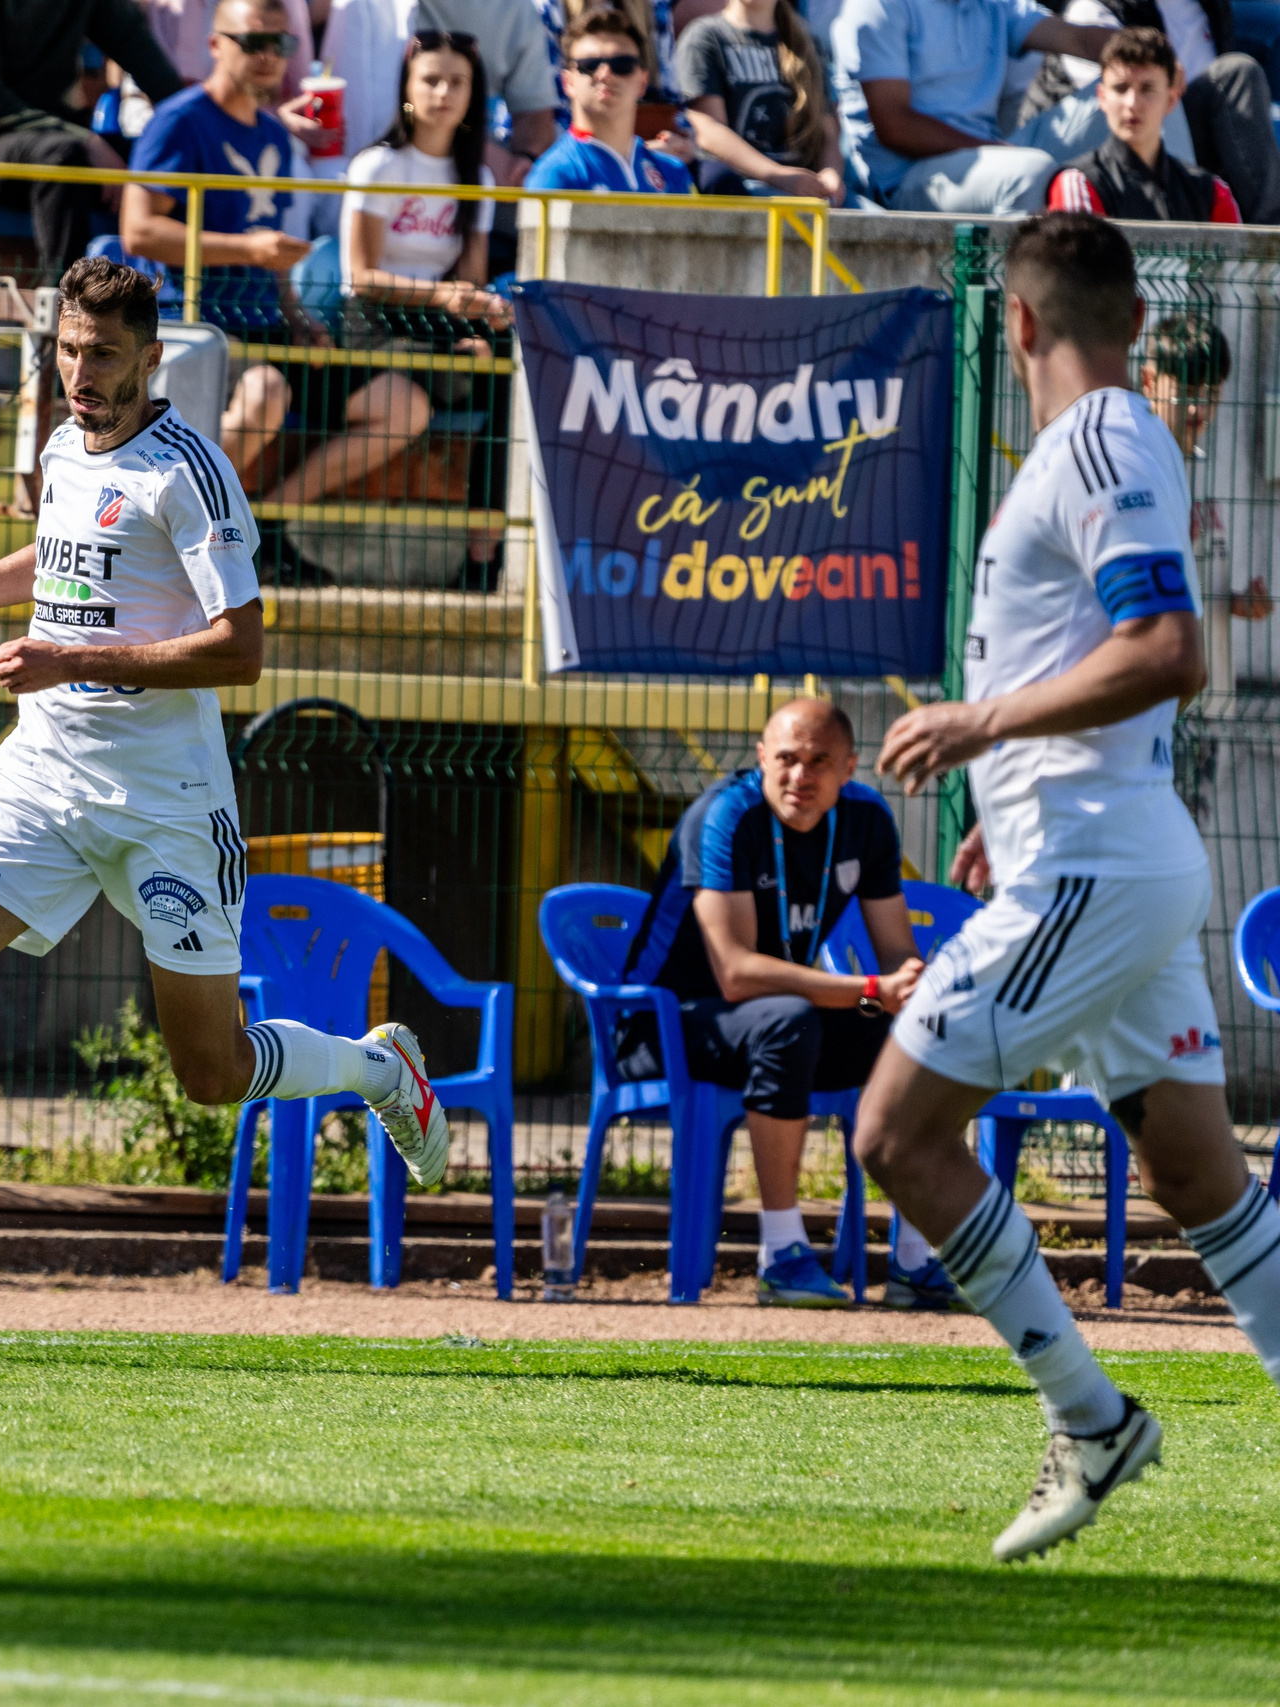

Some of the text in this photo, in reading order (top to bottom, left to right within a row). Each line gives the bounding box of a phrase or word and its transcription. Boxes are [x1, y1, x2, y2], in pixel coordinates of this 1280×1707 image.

[559, 354, 904, 444] Mândru
[738, 418, 900, 541] sunt
[56, 607, 82, 625] SPRE
[83, 610, 107, 626] 0%
[141, 880, 202, 910] FIVE CONTINENTS
